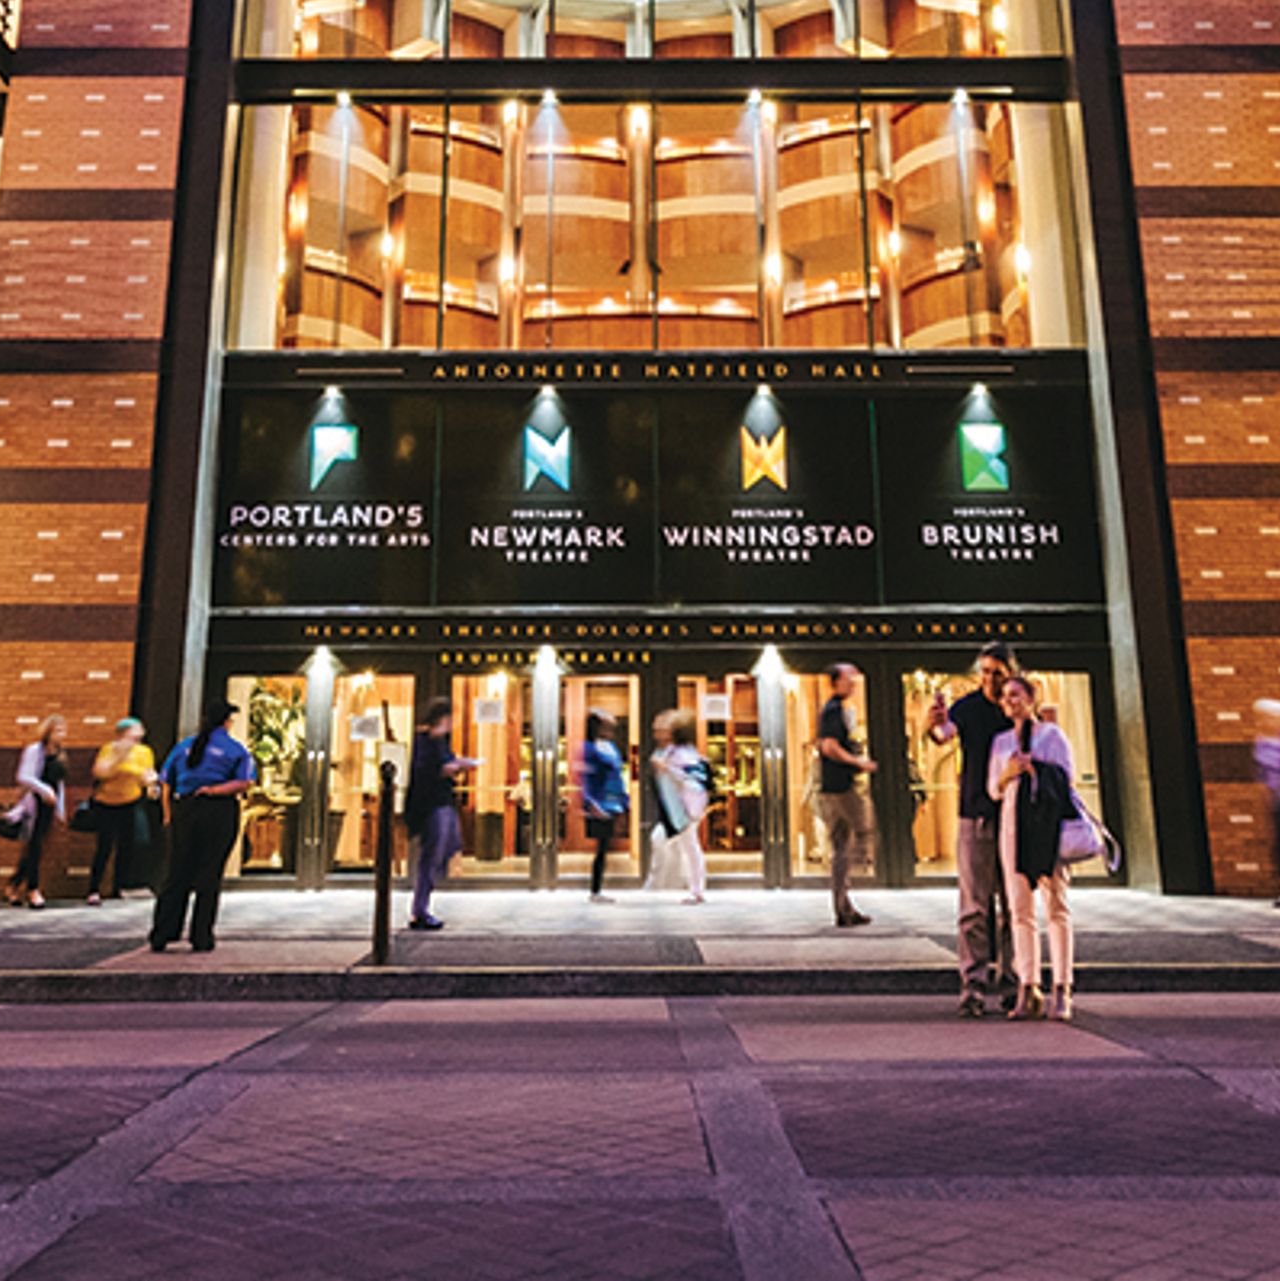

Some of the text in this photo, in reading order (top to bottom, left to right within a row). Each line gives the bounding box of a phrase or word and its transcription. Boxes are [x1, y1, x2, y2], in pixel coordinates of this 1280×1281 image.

[433, 363, 881, 378] ANTOINETTE HATFIELD HALL
[229, 504, 424, 528] PORTLAND'S
[511, 508, 583, 519] PORTLAND'S
[220, 532, 432, 547] CENTERS FOR THE ARTS
[470, 525, 626, 547] NEWMARK
[662, 524, 875, 547] WINNINGSTAD
[922, 523, 1059, 545] BRUNISH
[505, 549, 590, 563] THEATRE
[727, 548, 811, 563] THEATRE
[949, 547, 1034, 561] THEATRE
